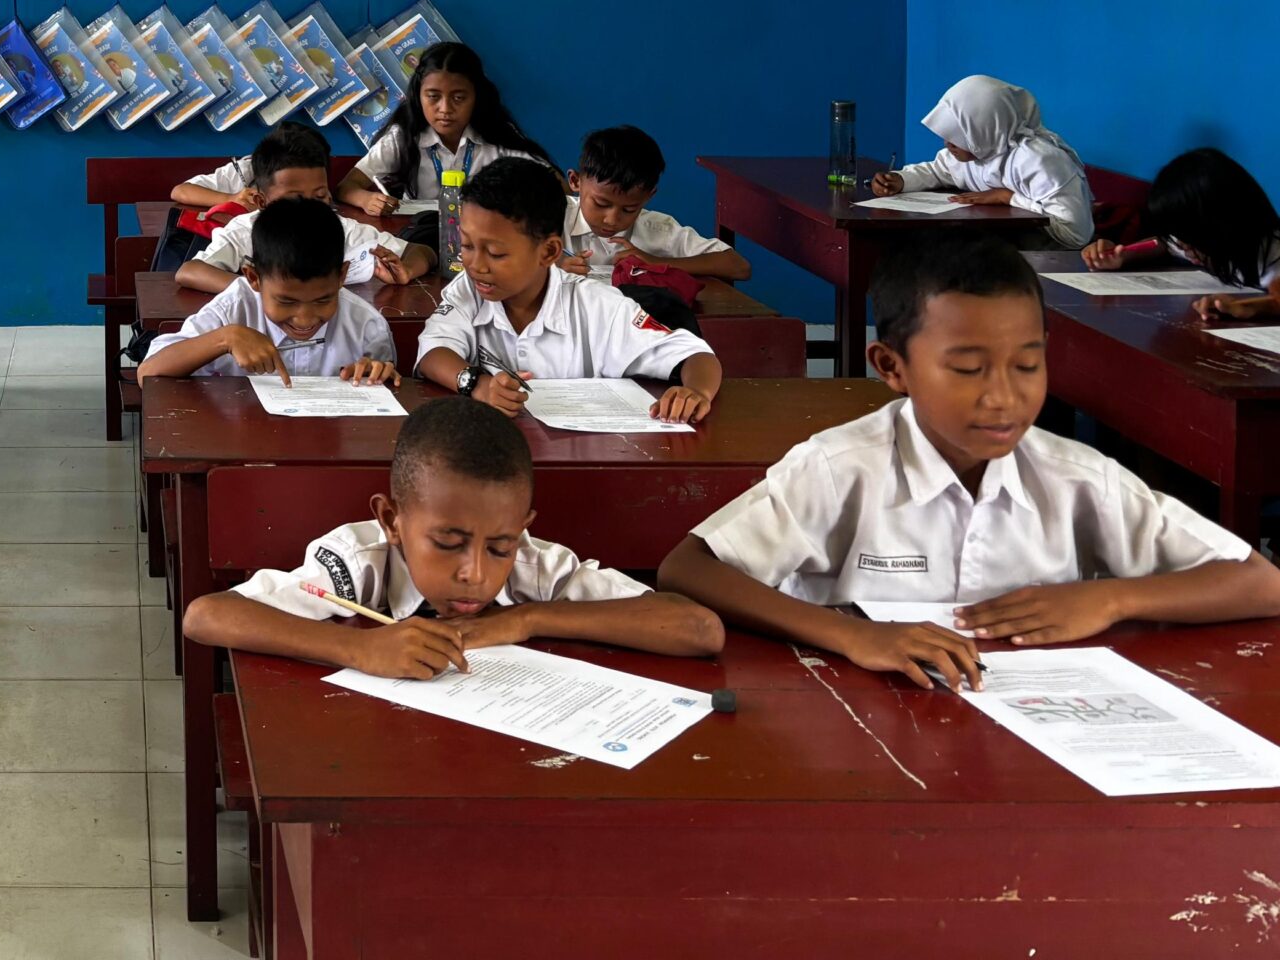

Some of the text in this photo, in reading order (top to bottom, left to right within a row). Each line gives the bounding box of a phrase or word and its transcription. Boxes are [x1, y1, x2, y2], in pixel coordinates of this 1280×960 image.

[402, 37, 417, 49] GRADE
[318, 555, 335, 571] KOTA
[332, 557, 351, 586] INPRES
